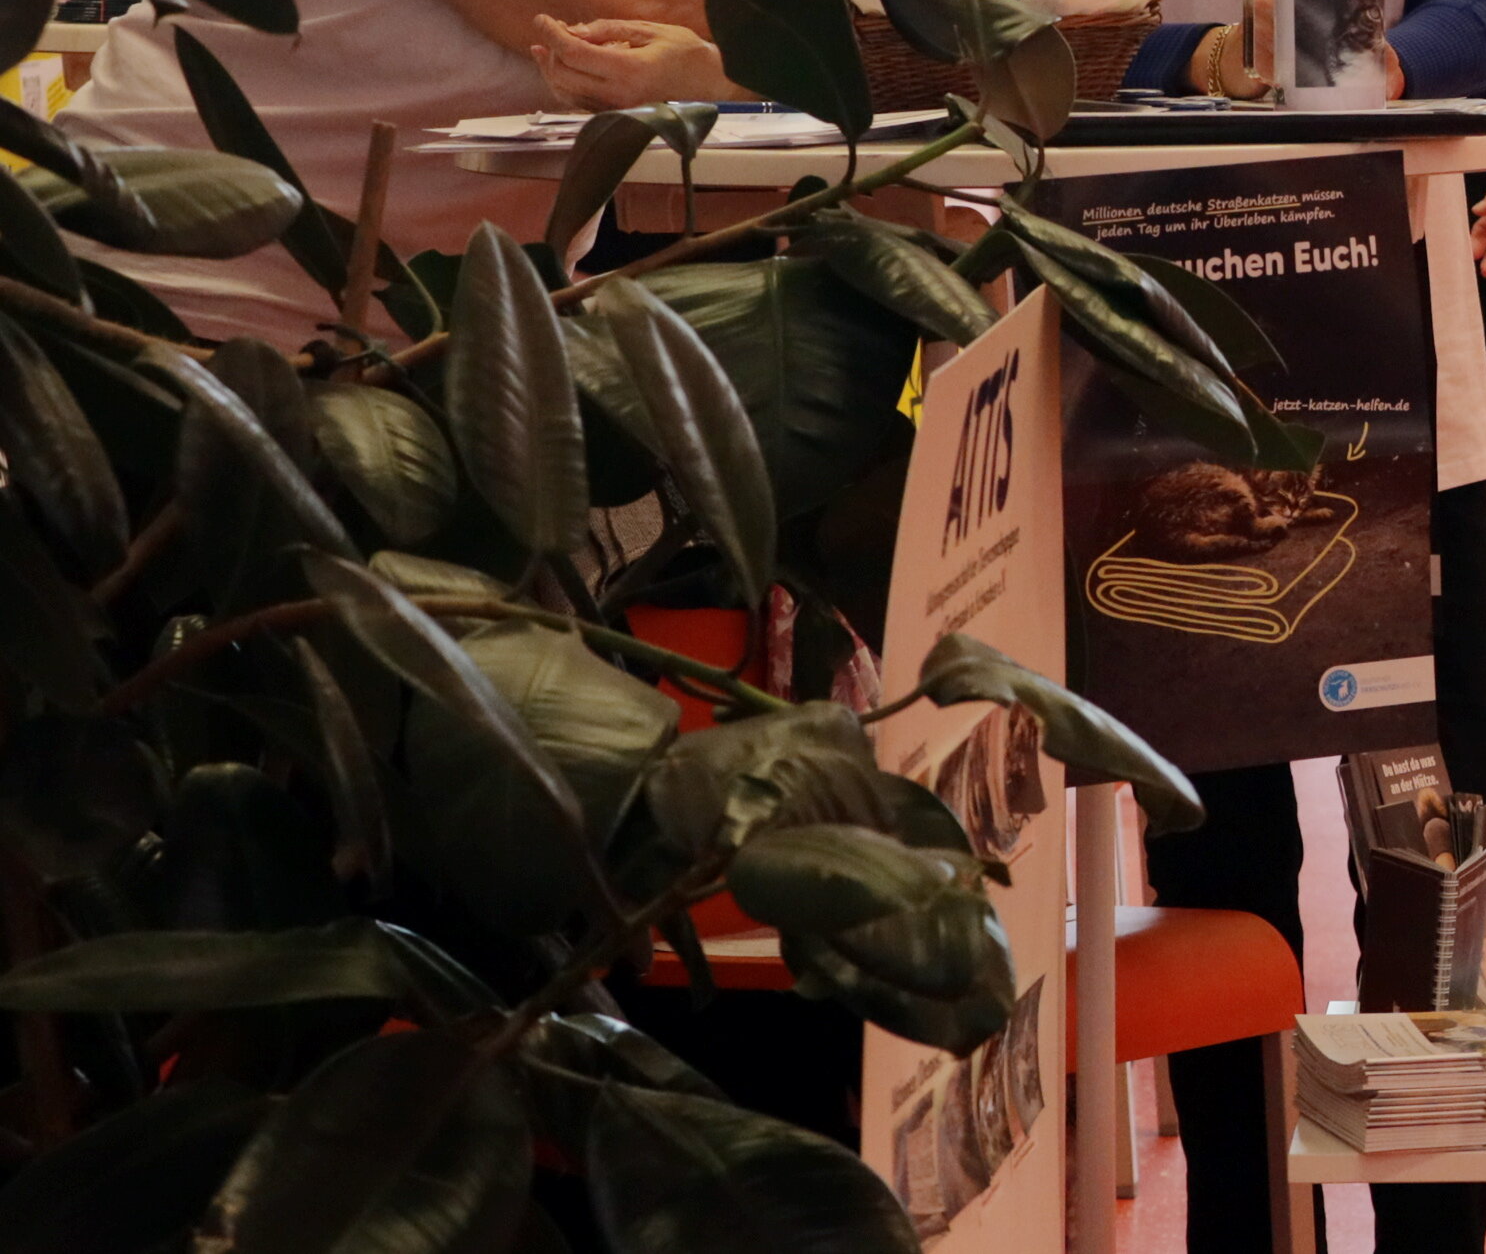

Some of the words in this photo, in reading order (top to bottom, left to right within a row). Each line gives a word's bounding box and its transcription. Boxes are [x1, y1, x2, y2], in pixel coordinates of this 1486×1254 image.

[1082, 206, 1144, 222] Millionen
[1147, 201, 1203, 216] deutsche
[1206, 192, 1299, 212] Straßenkatzen
[1301, 189, 1344, 203] müssen
[1095, 226, 1132, 241] jeden
[1137, 223, 1160, 238] Tag
[1165, 222, 1186, 233] um
[1190, 218, 1209, 230] ihr
[1214, 212, 1275, 229] Überleben
[1280, 207, 1335, 225] kämpfen.
[1294, 235, 1379, 274] Euch!
[1272, 397, 1411, 414] jetzt-katzen-helfen.de
[1382, 763, 1394, 777] Du
[1392, 759, 1411, 775] hast
[1410, 757, 1421, 771] da
[1420, 756, 1436, 769] was
[1390, 783, 1401, 795] an
[1400, 778, 1414, 792] der
[1412, 773, 1440, 789] Mütze.
